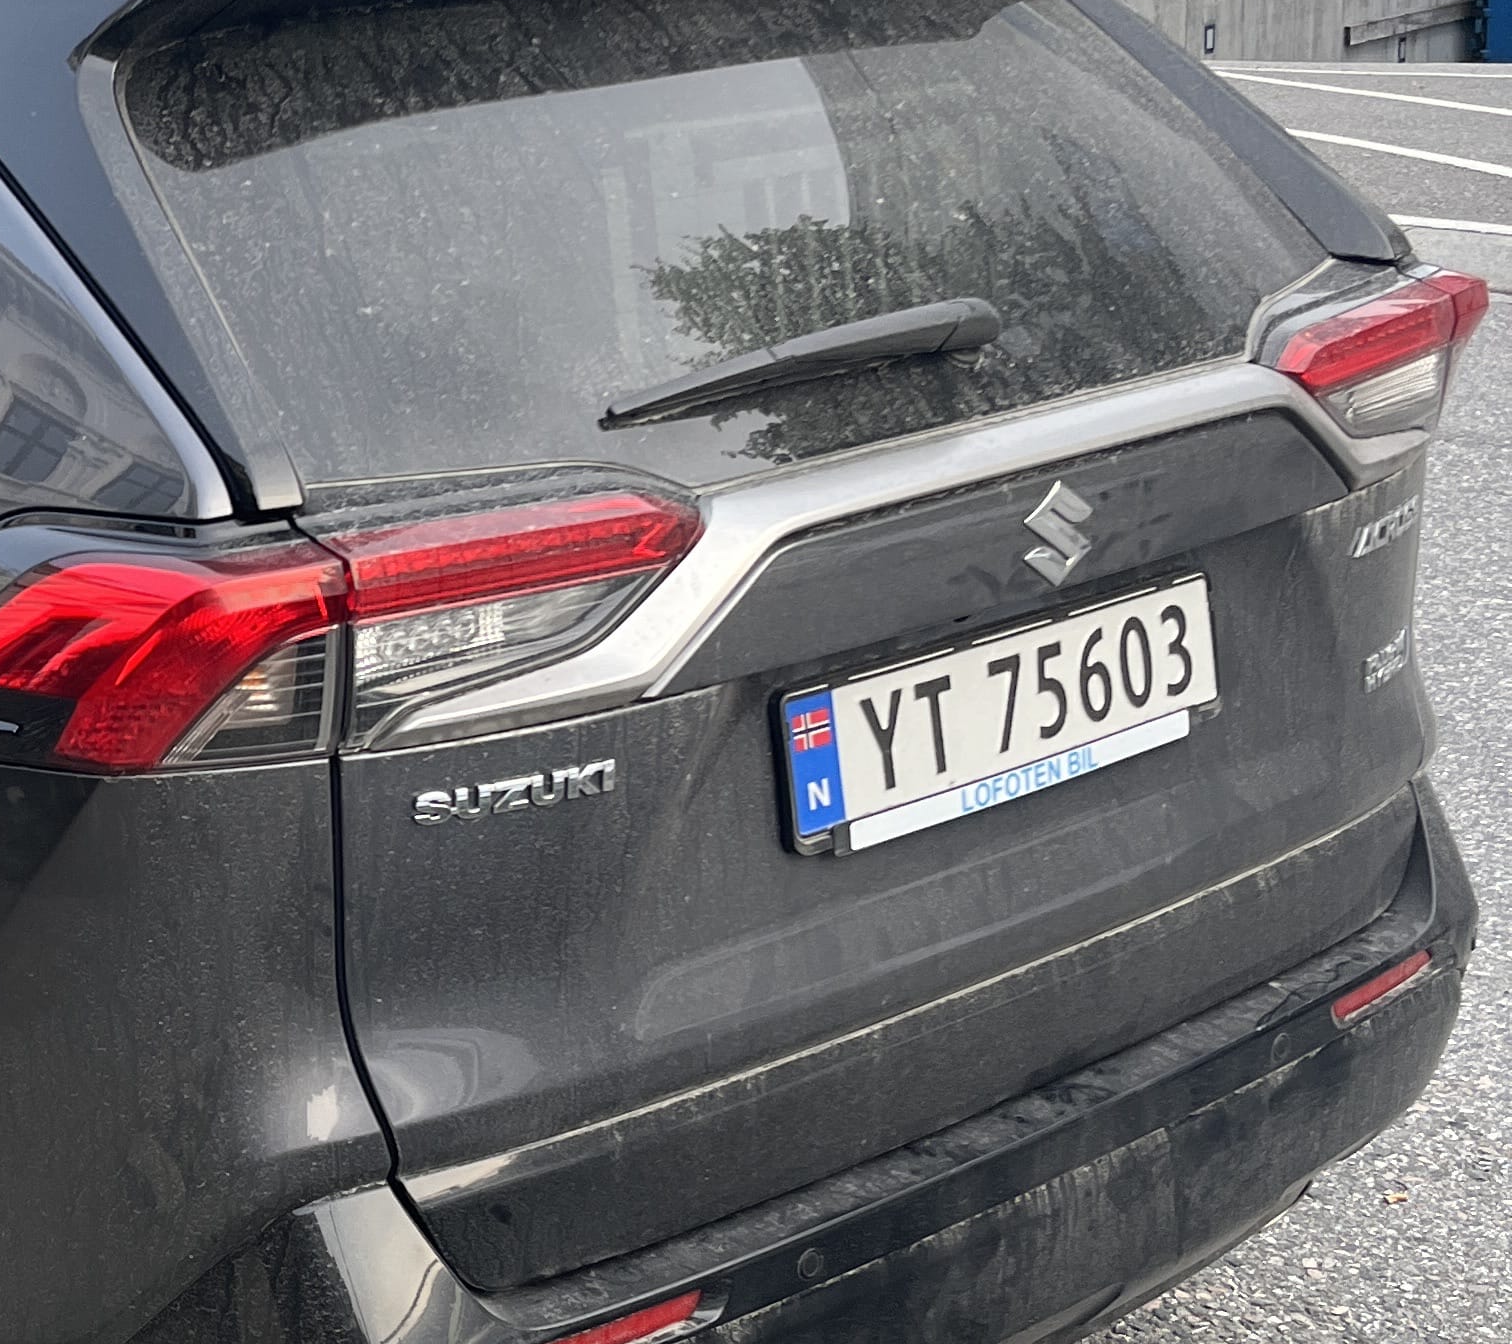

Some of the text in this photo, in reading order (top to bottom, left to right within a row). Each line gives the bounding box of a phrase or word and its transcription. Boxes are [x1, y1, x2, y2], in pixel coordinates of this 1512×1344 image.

[860, 604, 1192, 790] YT 75603
[413, 758, 616, 826] SUZUKI
[808, 777, 831, 811] N
[961, 747, 1098, 813] LOFOTEN BIL
